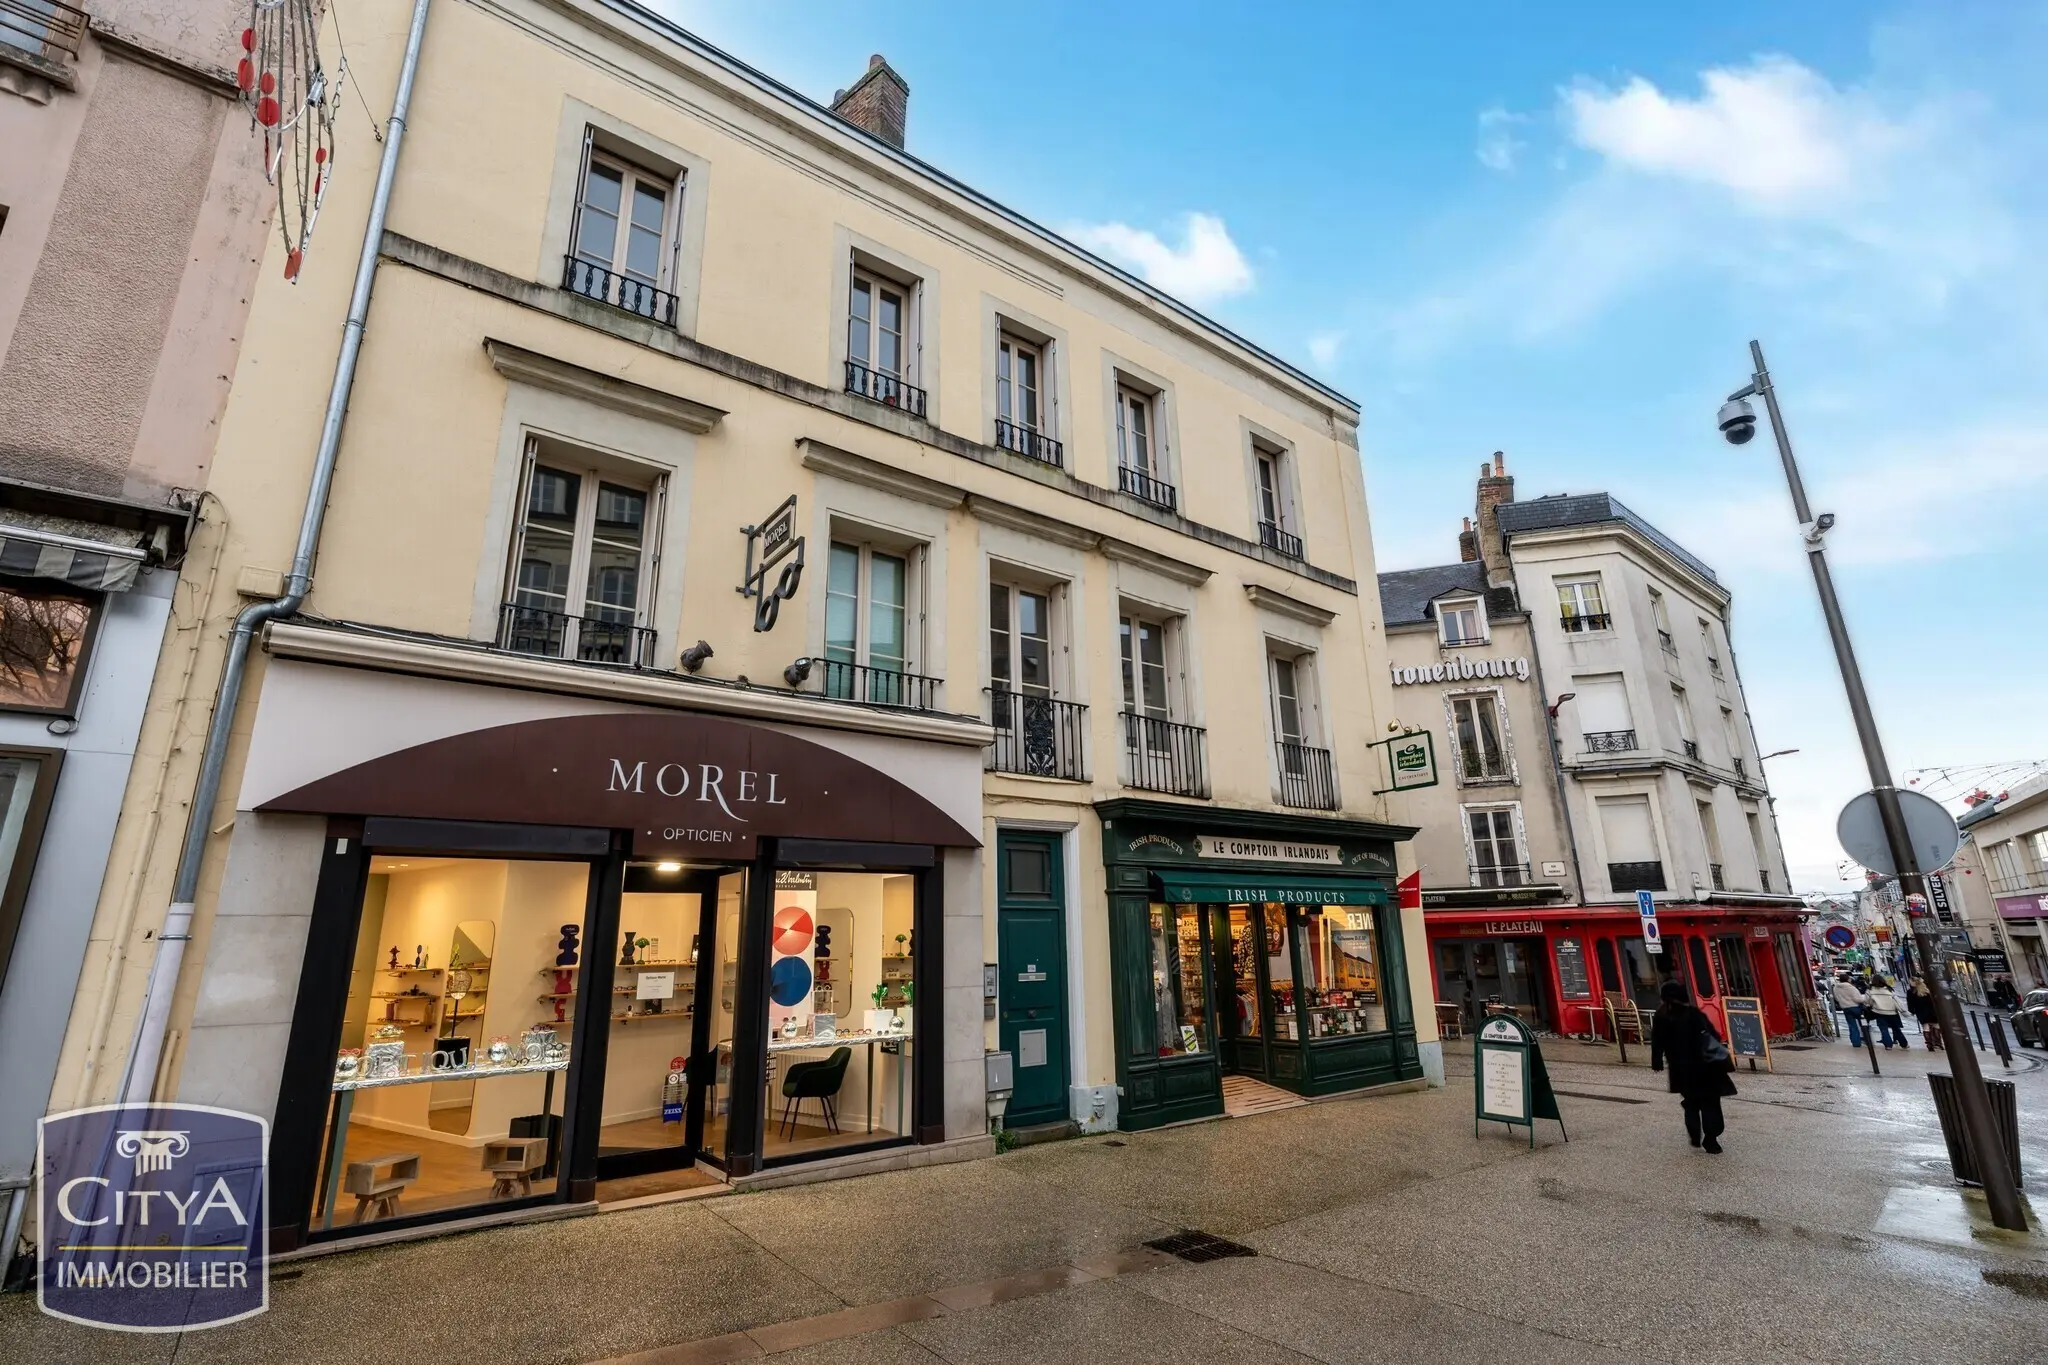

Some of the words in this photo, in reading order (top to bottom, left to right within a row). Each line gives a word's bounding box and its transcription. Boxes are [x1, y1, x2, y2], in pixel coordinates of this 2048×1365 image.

[765, 521, 788, 548] MOREL
[1390, 653, 1530, 686] ronenbourg
[606, 758, 786, 822] MOREL
[663, 827, 732, 843] OPTICIEN
[1129, 835, 1148, 852] IRISH
[1149, 834, 1184, 855] PRODUCTS
[1213, 841, 1225, 854] LE
[1230, 843, 1278, 857] COMPTOIR
[1284, 846, 1329, 860] IRLANDAIS
[1351, 853, 1362, 865] OUT
[1368, 852, 1390, 868] IRELAND
[1227, 889, 1268, 902] IRISH
[1278, 890, 1345, 903] PRODUCTS
[1485, 922, 1498, 934] LE
[1500, 921, 1544, 934] PLATEAU
[663, 1107, 683, 1115] ZEISS
